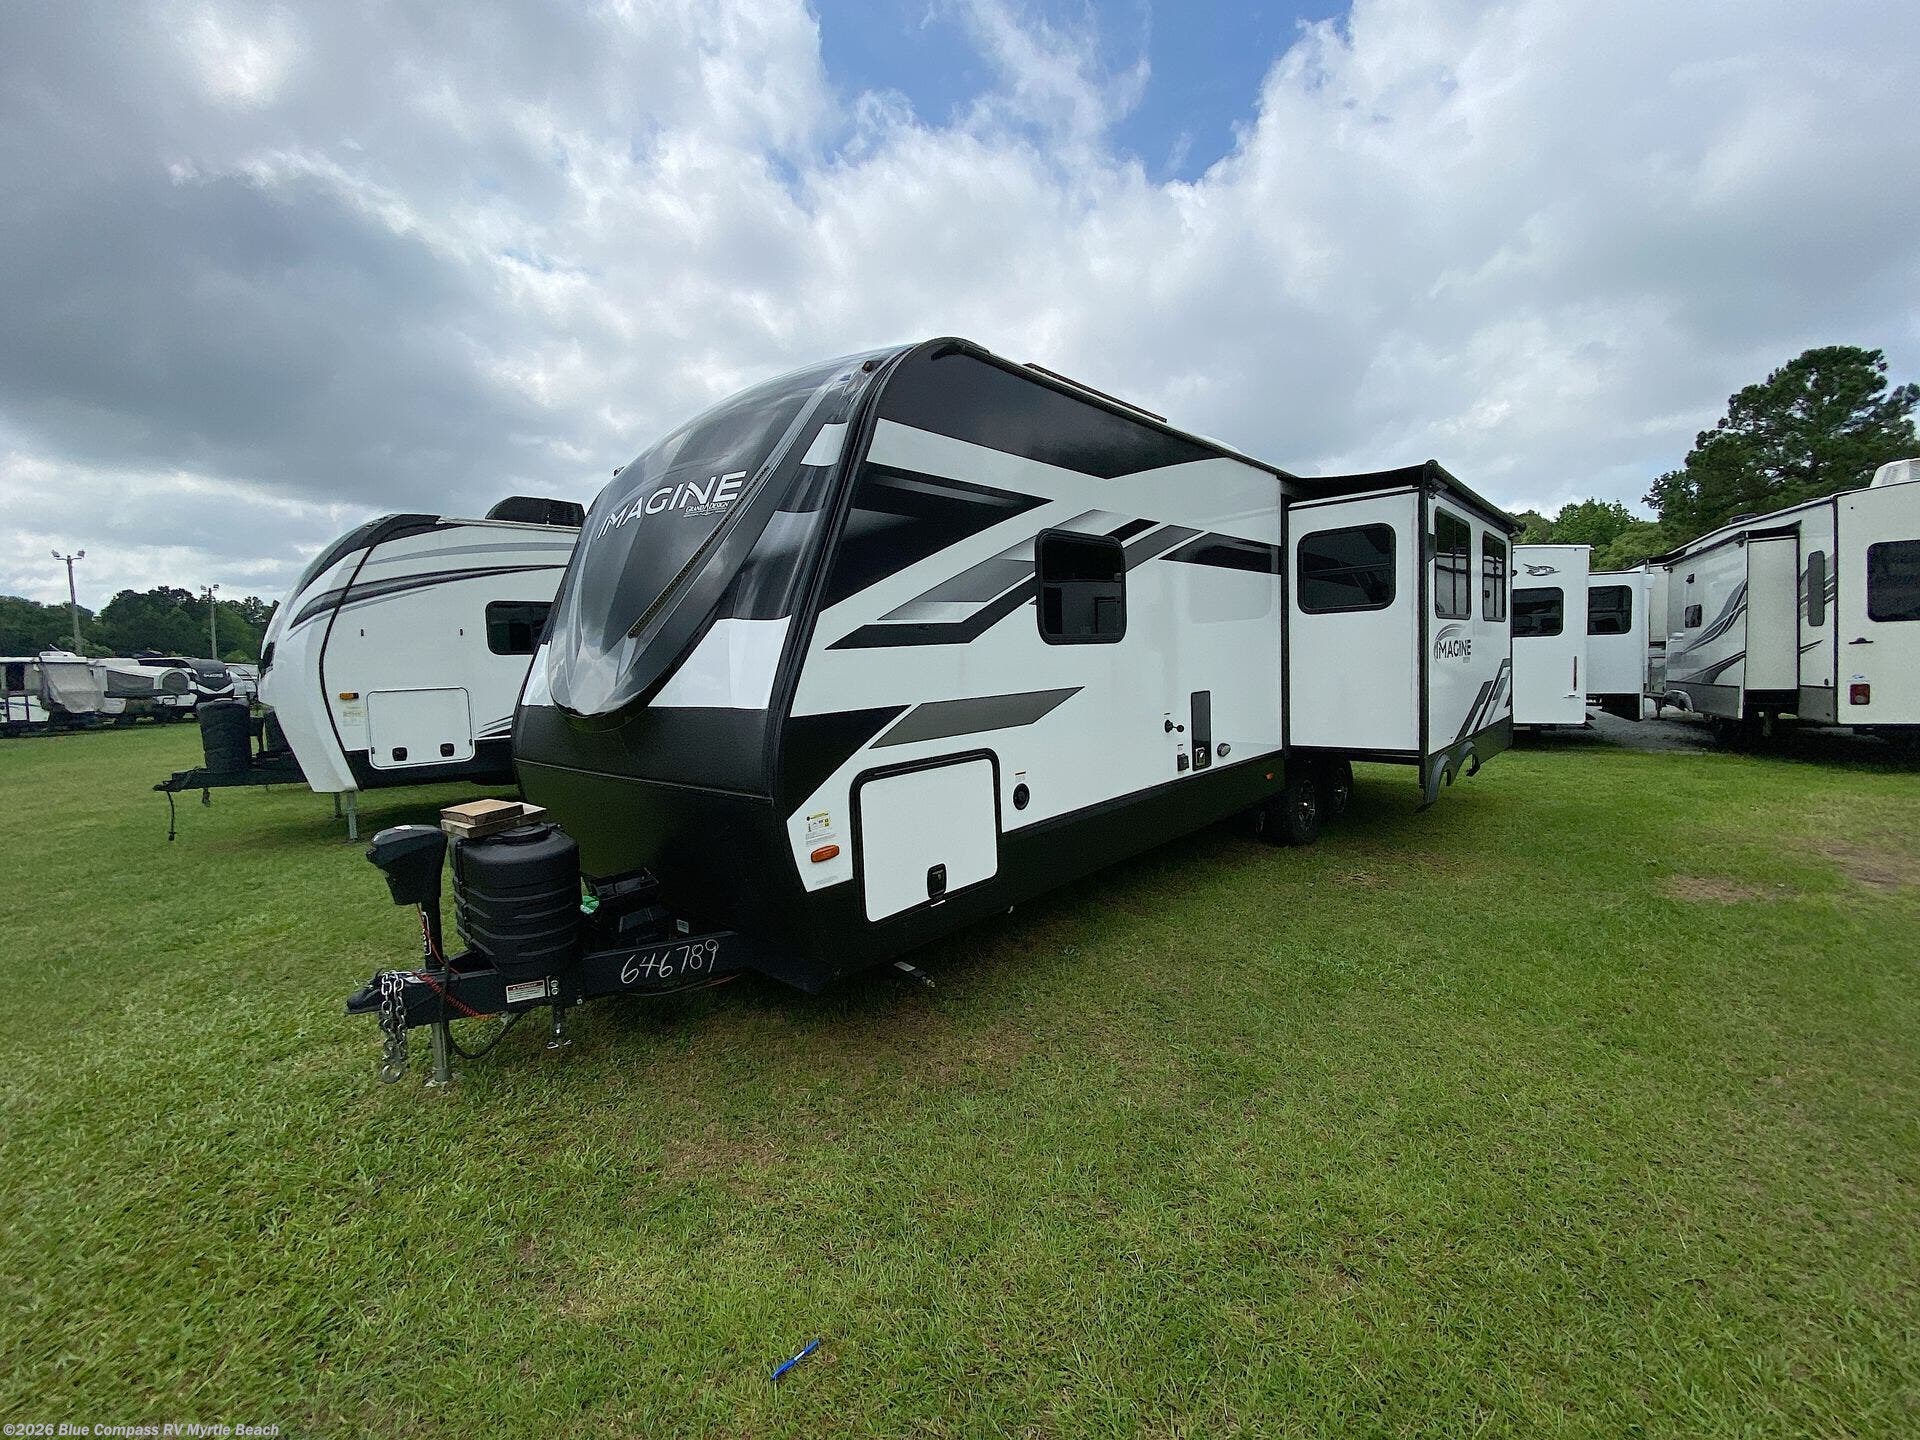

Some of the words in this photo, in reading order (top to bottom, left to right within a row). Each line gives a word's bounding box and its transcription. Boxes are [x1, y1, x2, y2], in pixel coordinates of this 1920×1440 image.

[597, 471, 747, 540] IMAGINE
[1436, 639, 1472, 659] IMAGINE
[621, 939, 719, 984] 646789
